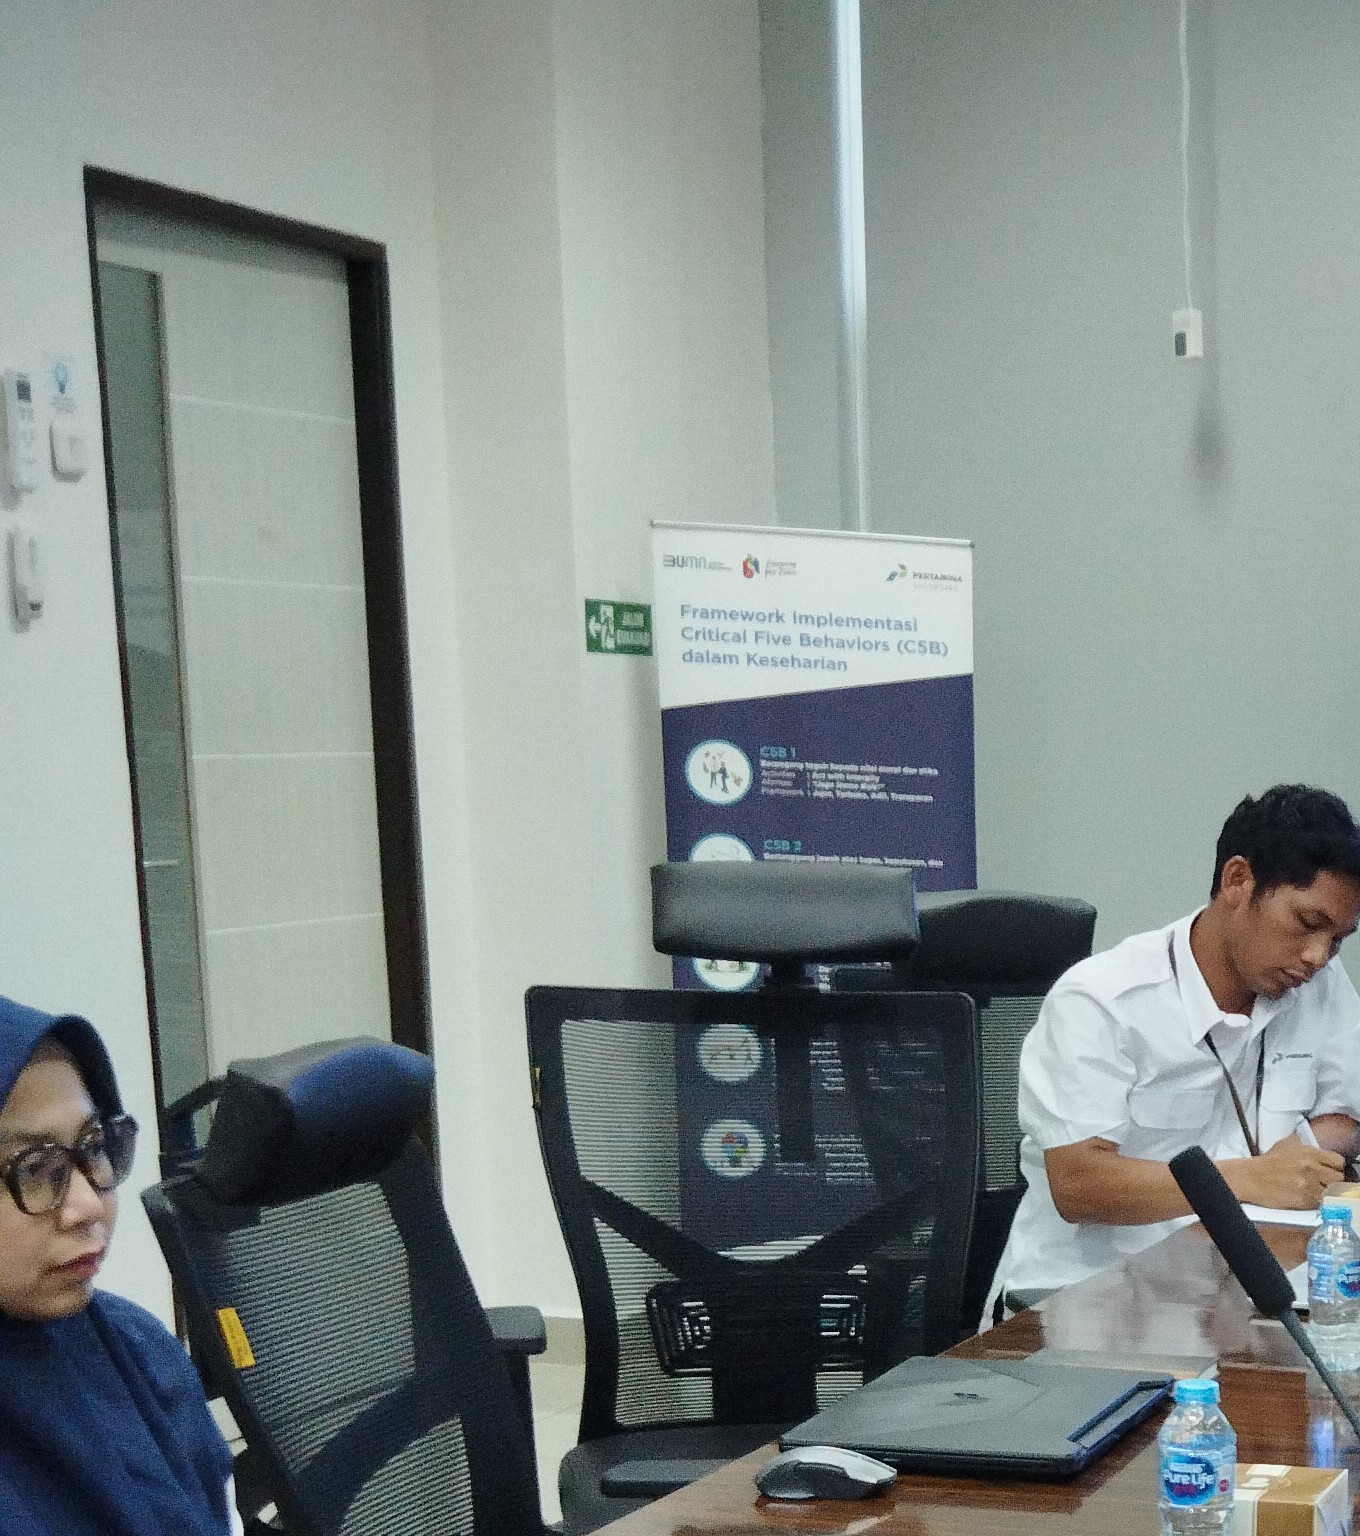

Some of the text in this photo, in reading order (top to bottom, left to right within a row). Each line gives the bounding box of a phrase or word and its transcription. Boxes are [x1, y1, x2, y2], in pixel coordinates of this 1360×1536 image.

[680, 603, 918, 632] Framework Implementasi
[680, 626, 747, 644] Critical
[754, 630, 792, 647] Five
[799, 632, 891, 652] Behaviors
[681, 648, 848, 672] dalam Keseharian
